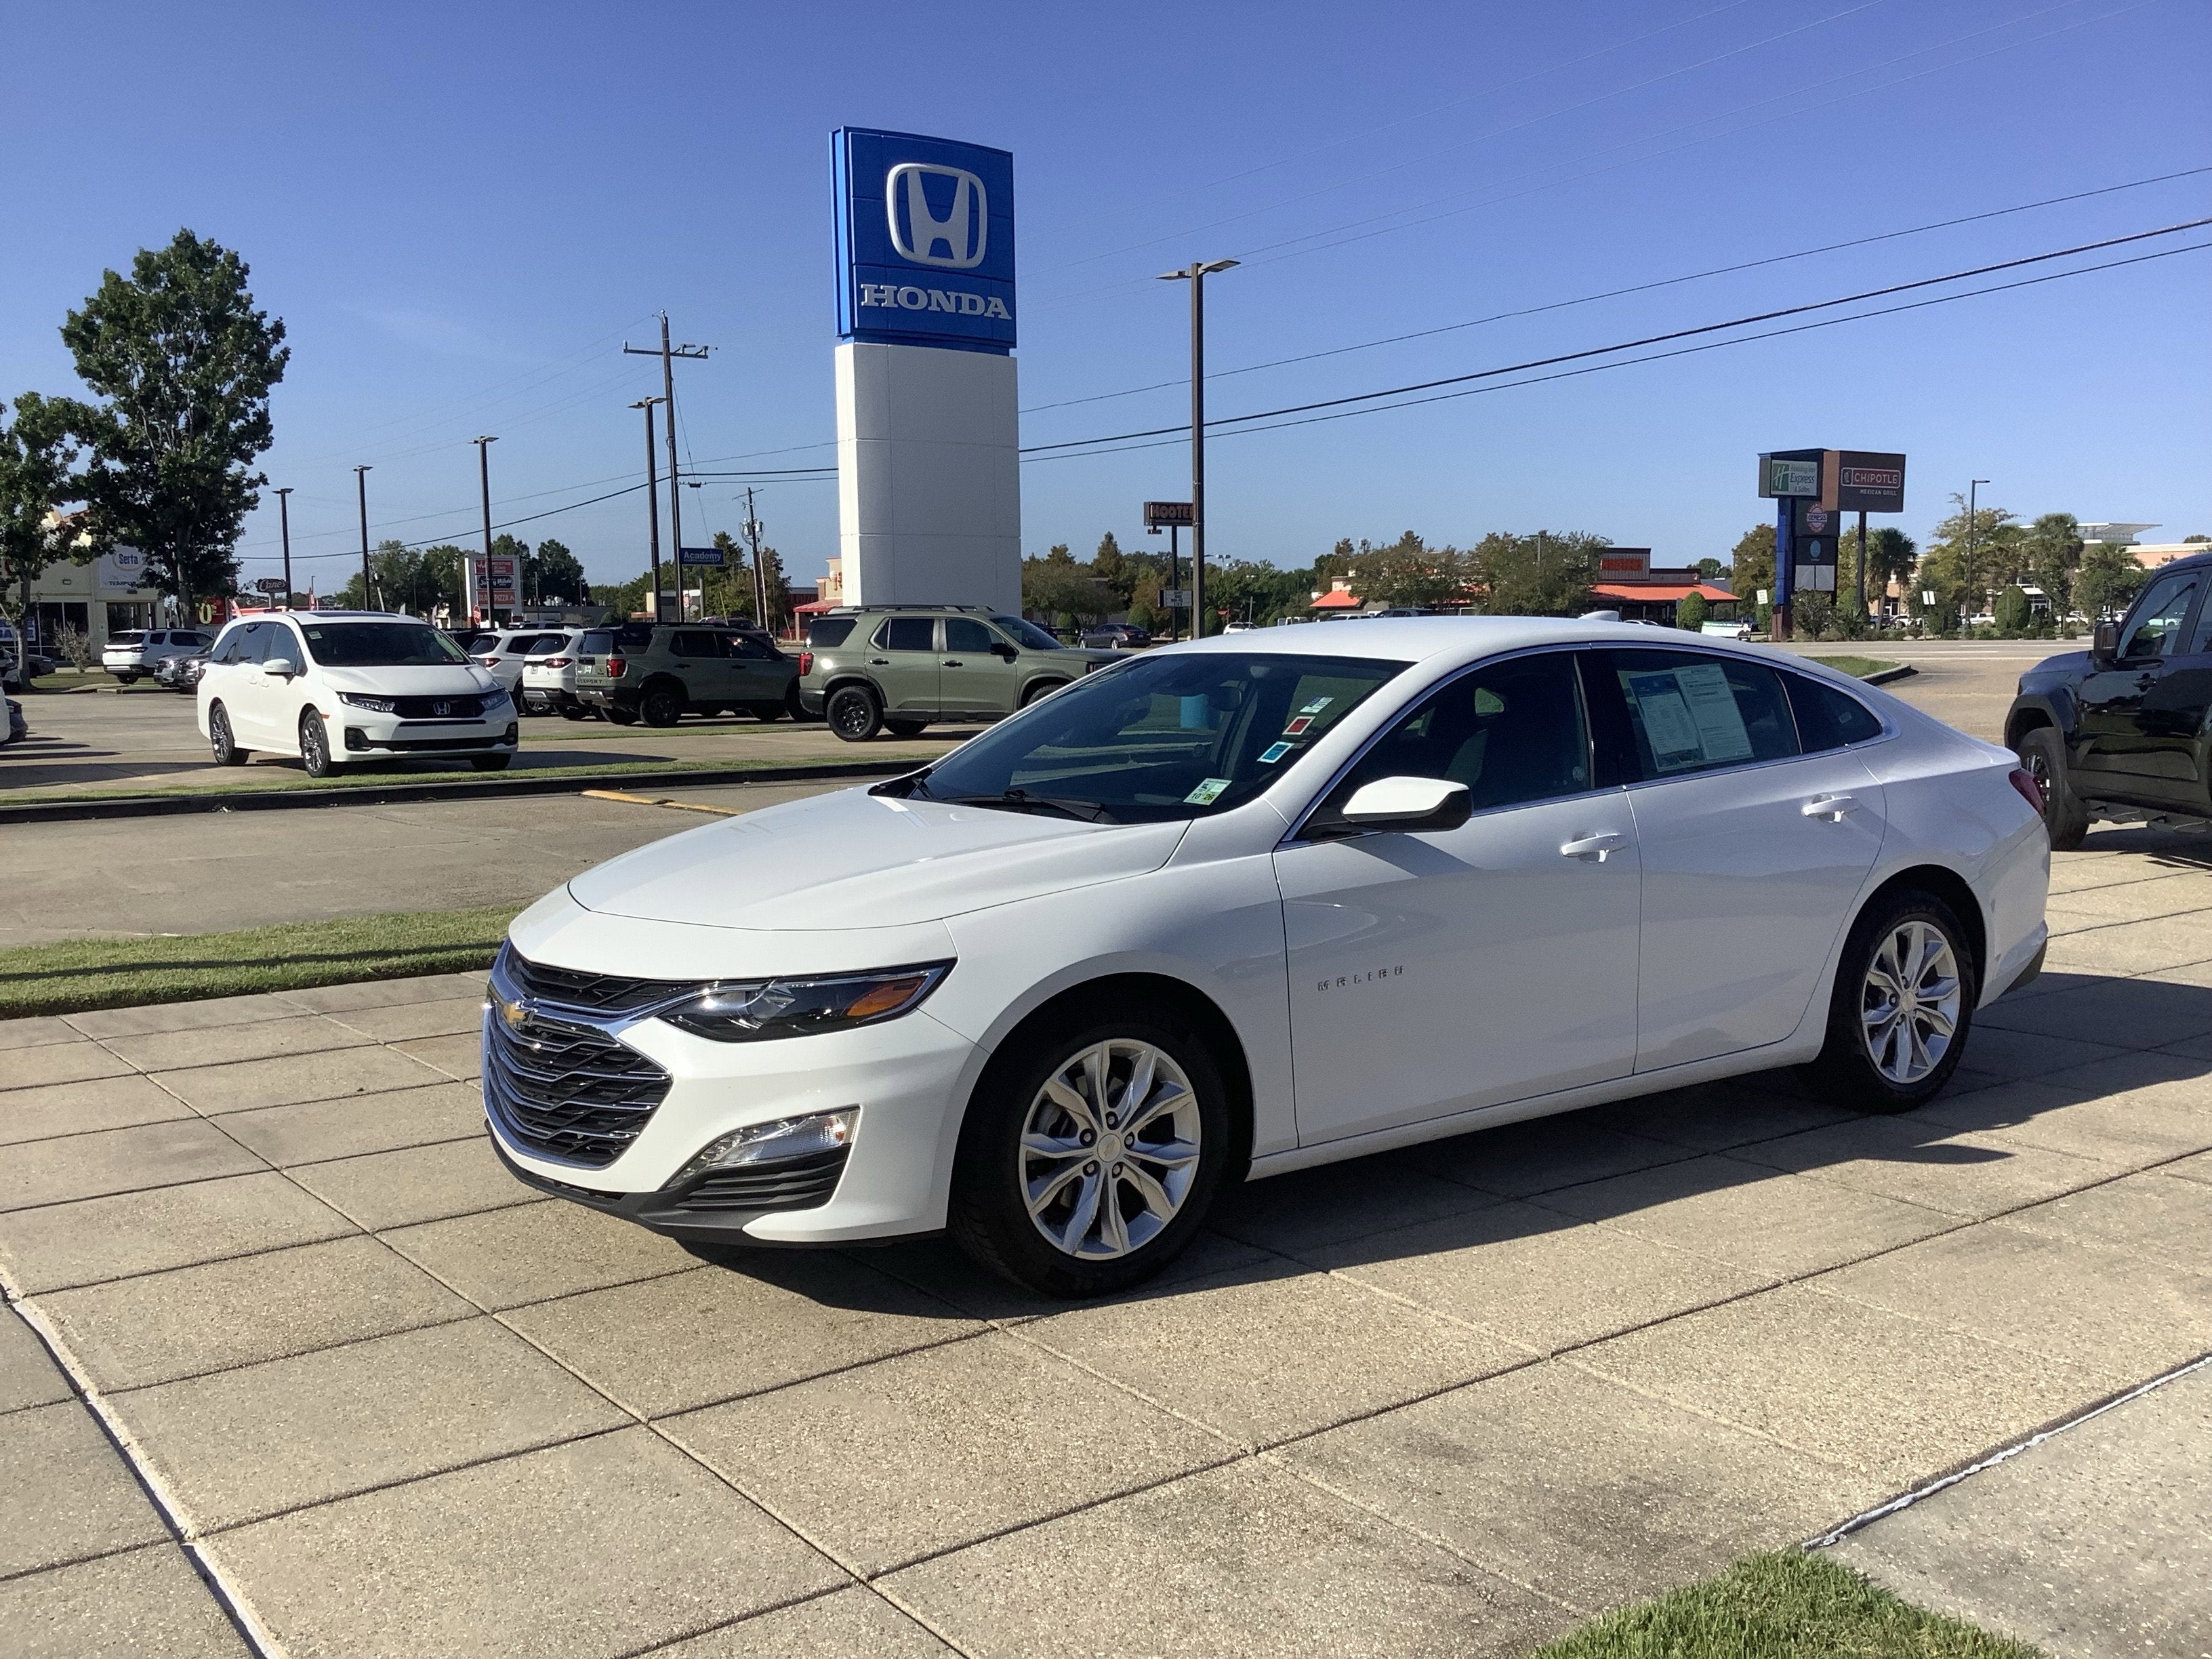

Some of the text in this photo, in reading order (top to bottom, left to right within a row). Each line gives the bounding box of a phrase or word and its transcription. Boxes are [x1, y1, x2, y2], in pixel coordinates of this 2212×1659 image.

[860, 283, 1012, 321] HONDA
[1790, 472, 1816, 485] Express
[1853, 472, 1898, 484] CHIPOTLE
[119, 553, 138, 565] Serta
[683, 551, 722, 562] Academy
[259, 578, 286, 592] Cane's
[1317, 965, 1404, 991] MALIBU
